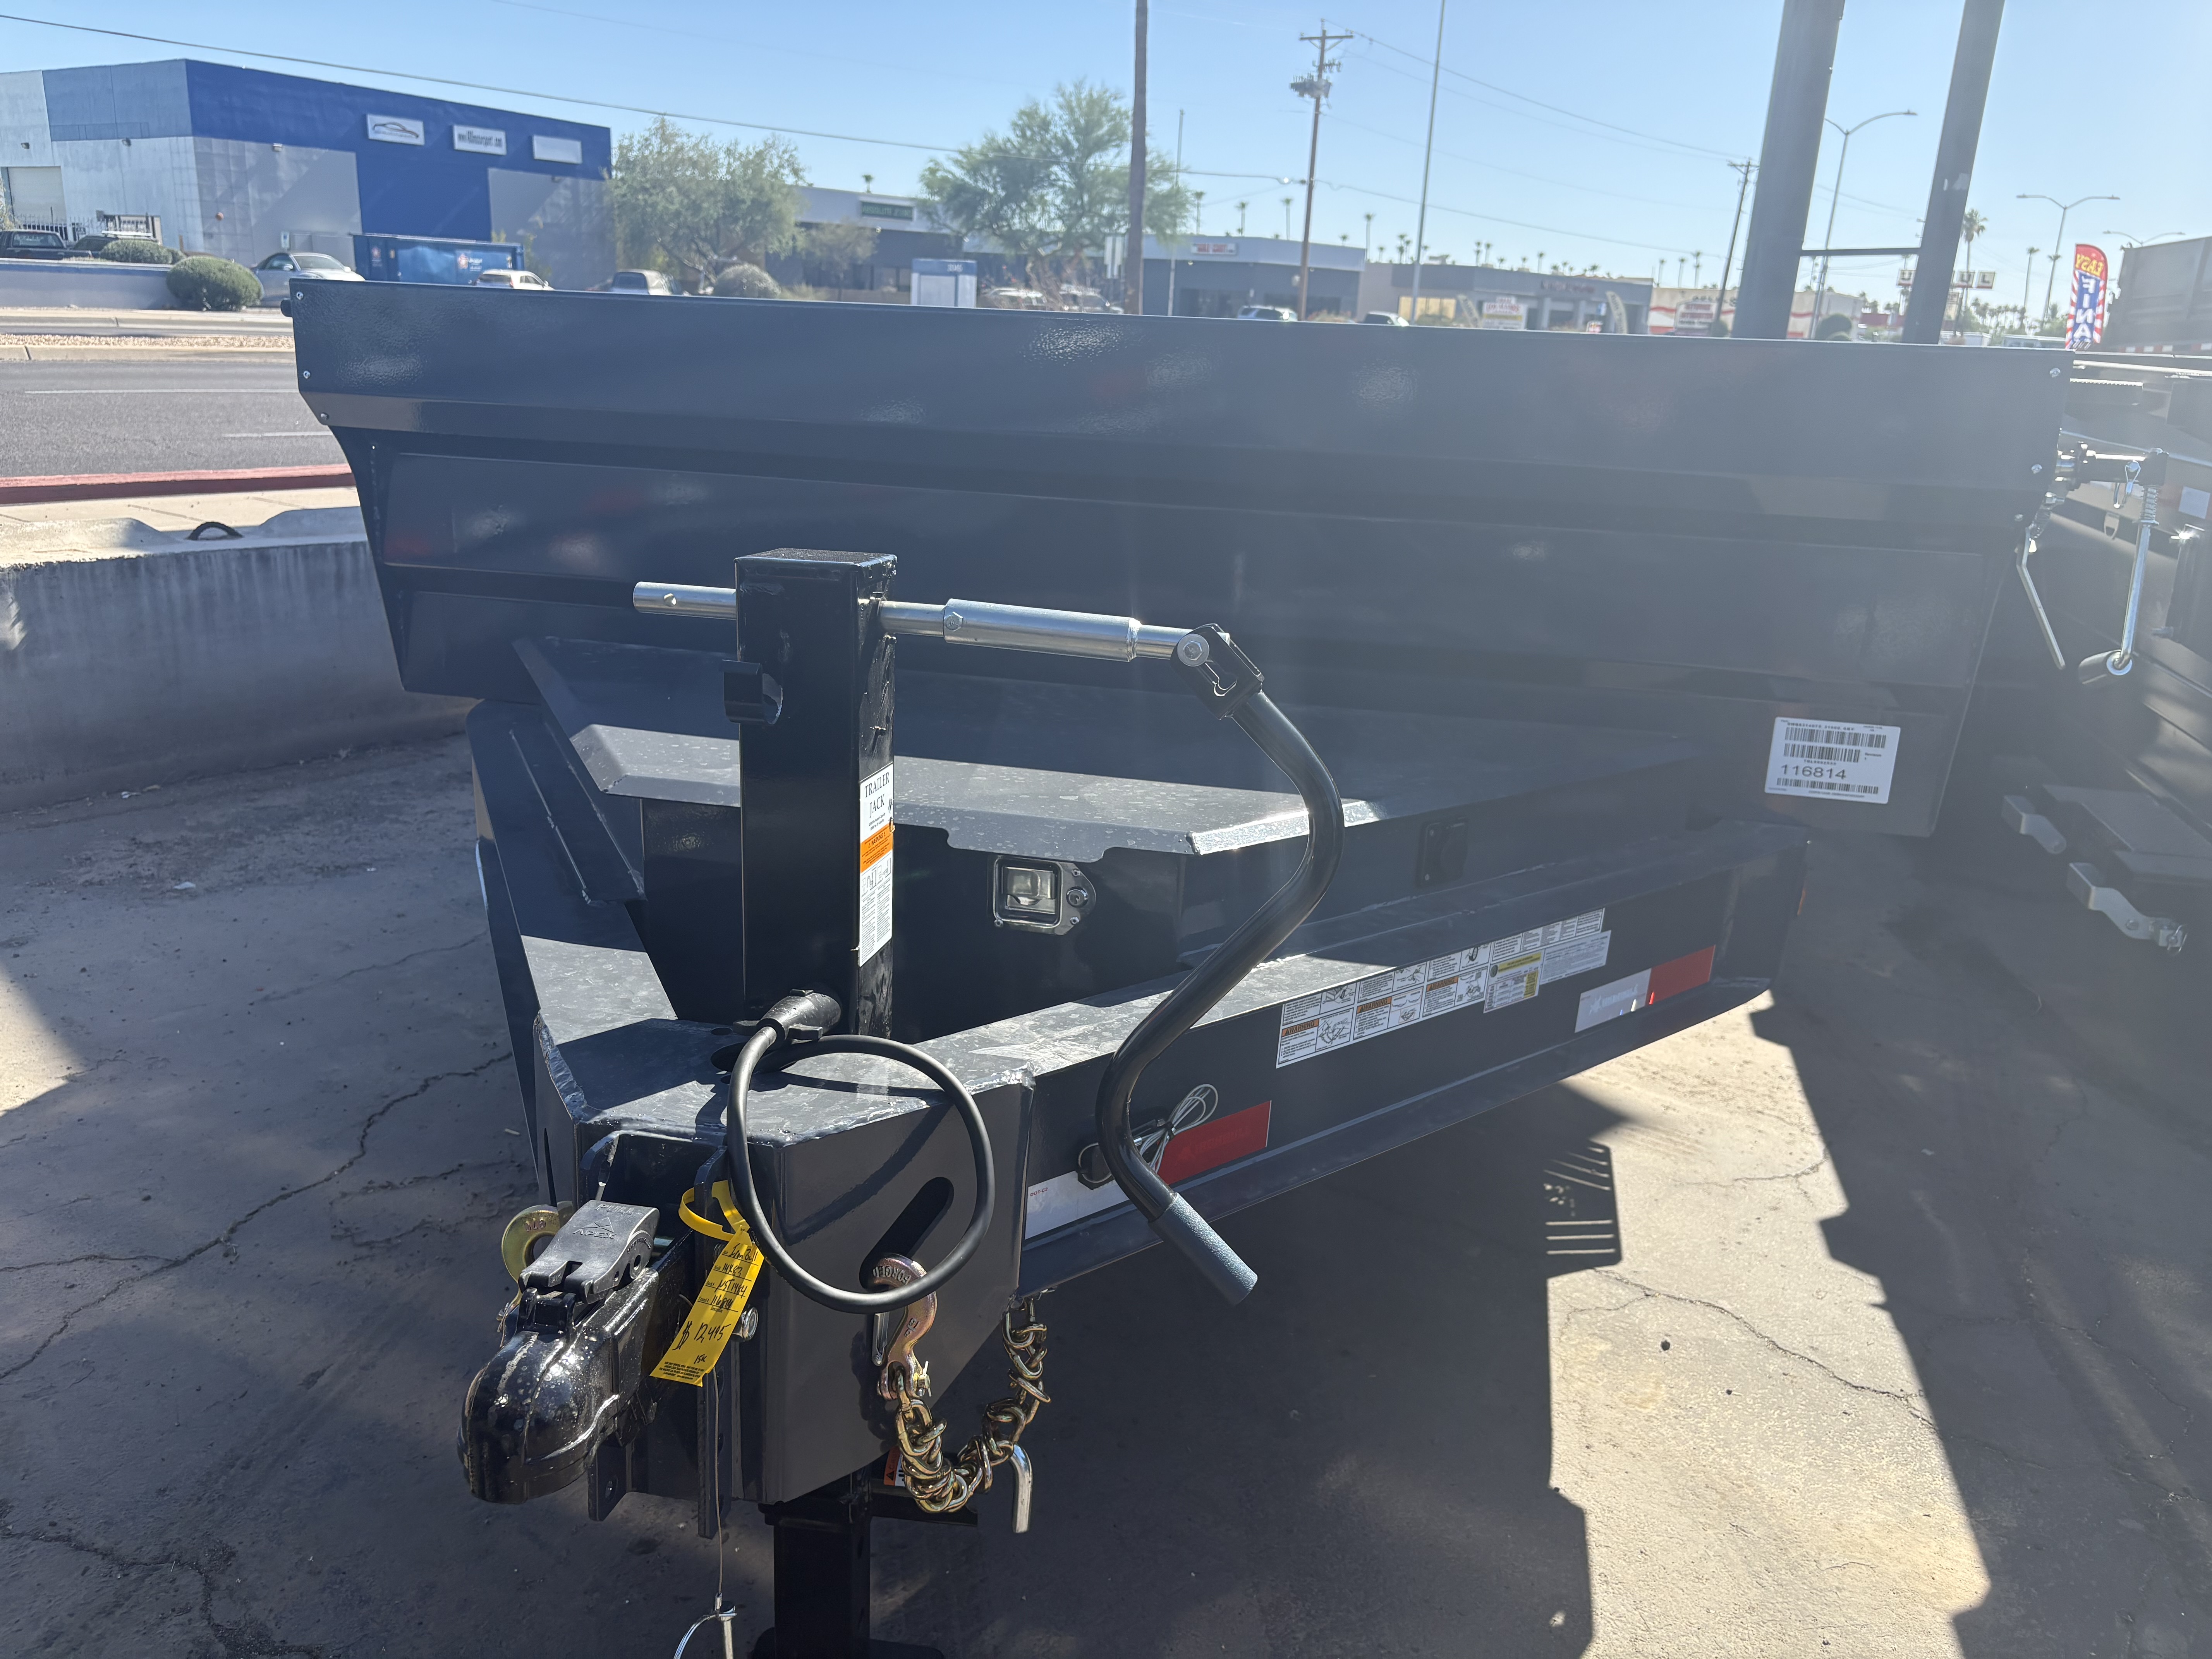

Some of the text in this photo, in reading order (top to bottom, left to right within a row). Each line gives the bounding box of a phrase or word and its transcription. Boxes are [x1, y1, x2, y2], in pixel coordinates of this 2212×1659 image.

[1781, 764, 1846, 780] 116814
[865, 772, 890, 798] TRAILER
[869, 793, 884, 818] JACK
[1363, 998, 1388, 1012] WARNING
[1289, 1021, 1315, 1034] WARNING
[1030, 1187, 1048, 1196] DOT-C2
[573, 1229, 617, 1240] APEX
[745, 1249, 758, 1262] Bull
[873, 1266, 912, 1285] FORGED
